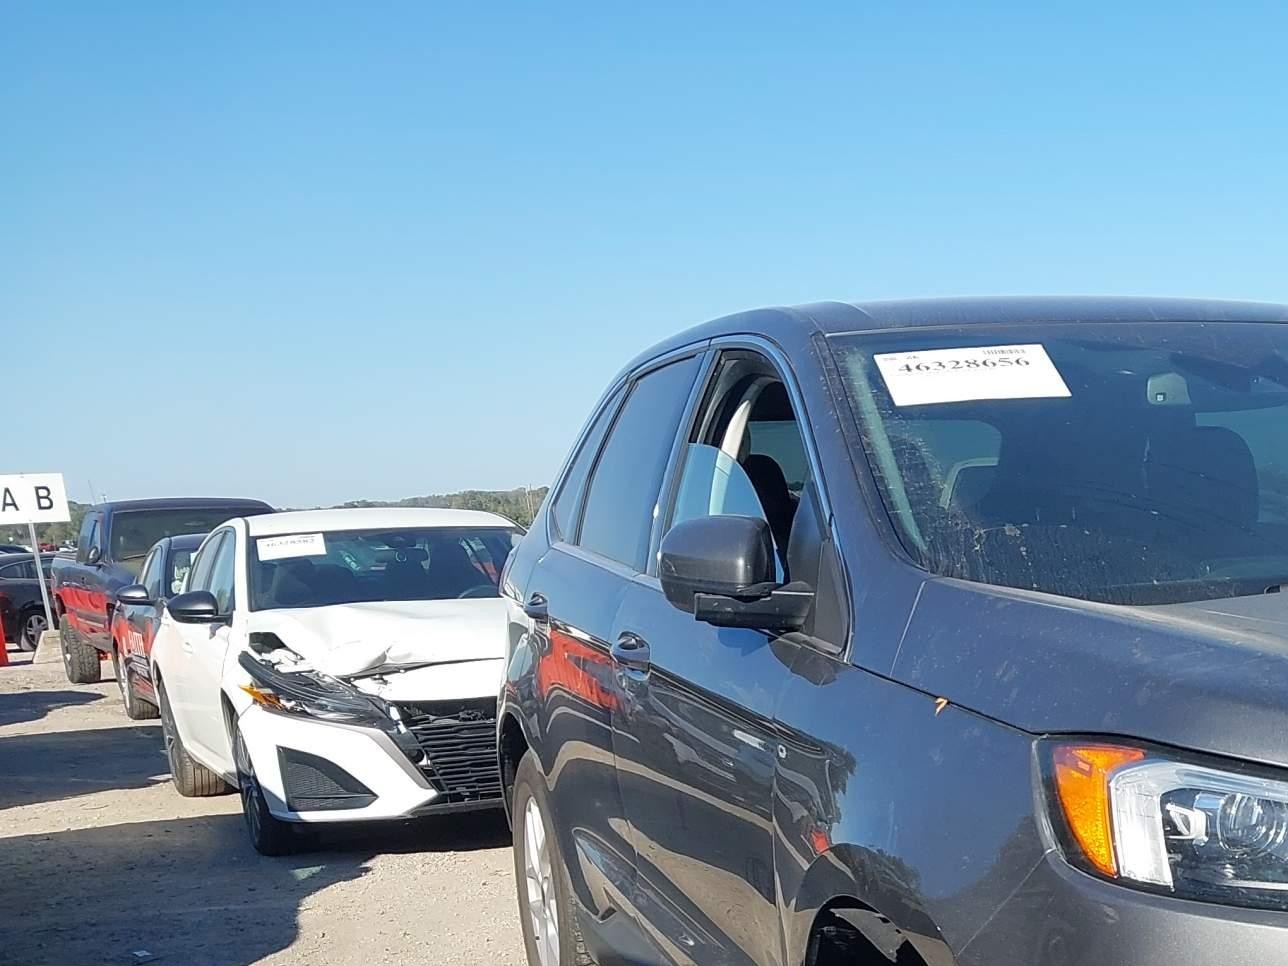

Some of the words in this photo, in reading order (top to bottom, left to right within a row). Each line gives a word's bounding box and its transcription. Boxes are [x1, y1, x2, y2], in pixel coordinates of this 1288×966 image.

[898, 357, 1031, 373] 46328656
[1, 486, 20, 513] A
[34, 485, 54, 511] B
